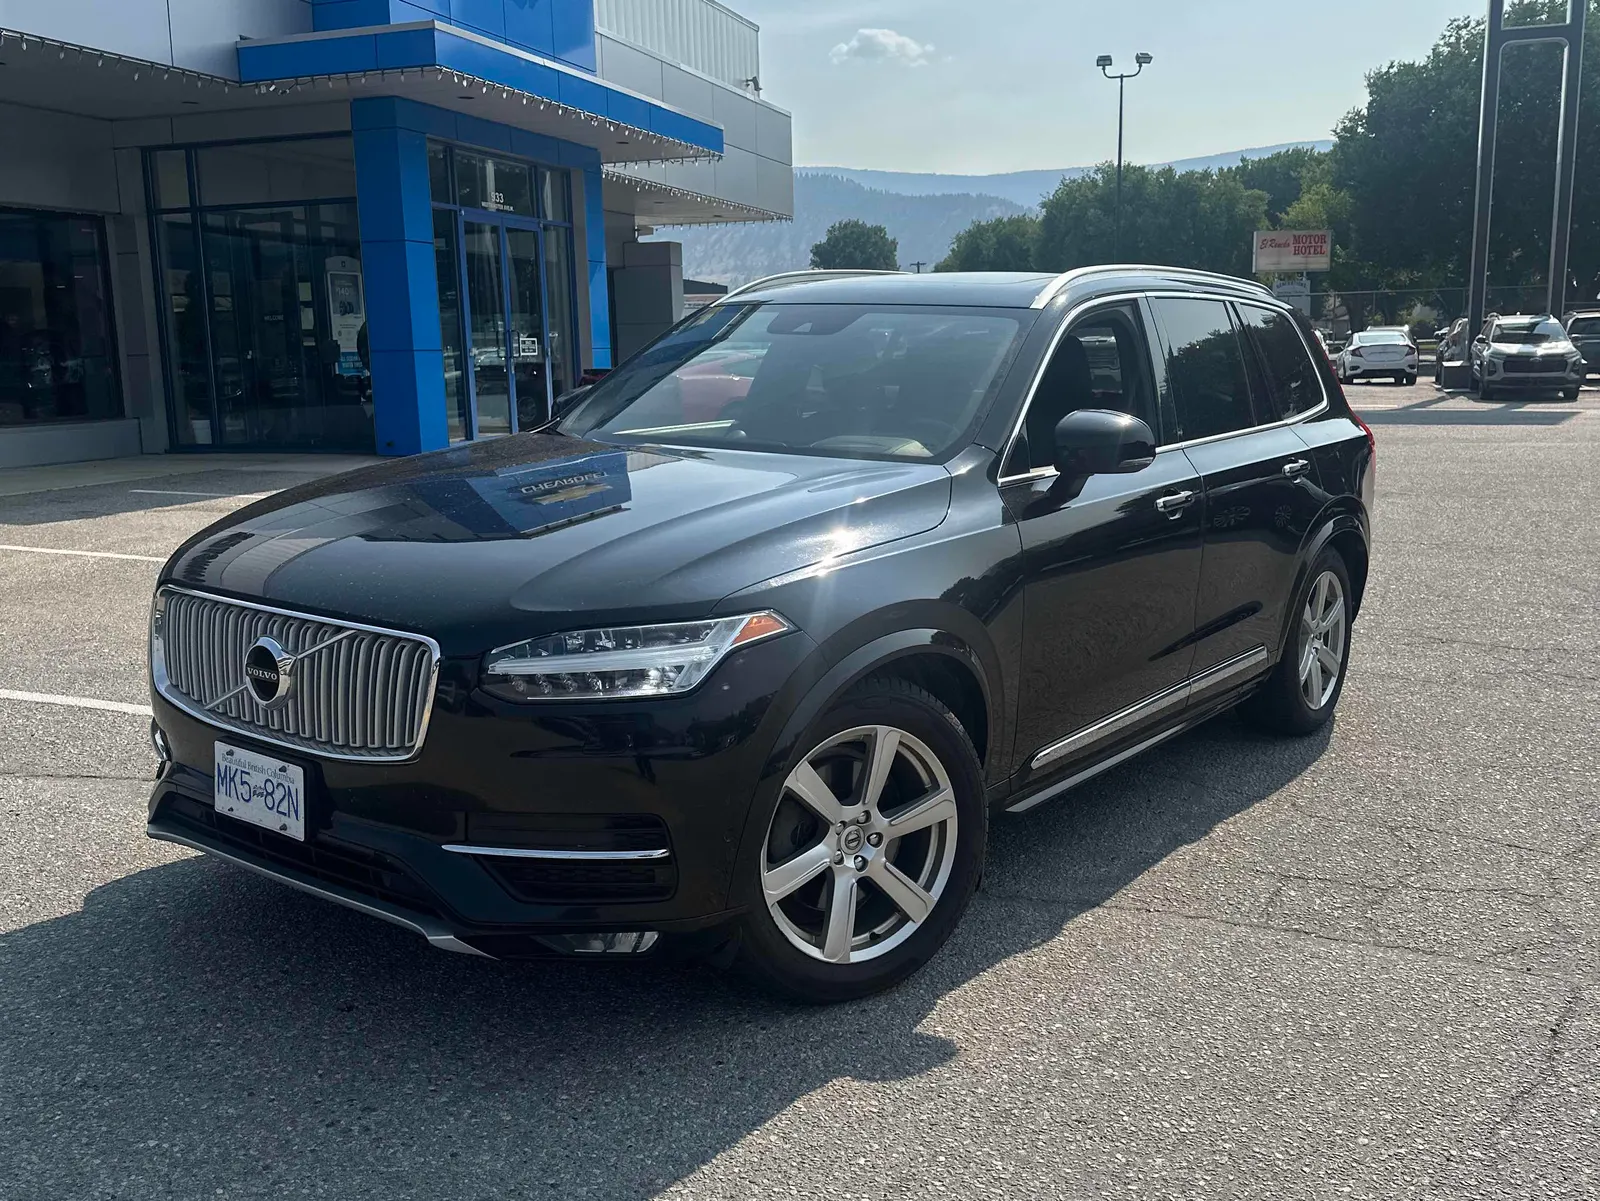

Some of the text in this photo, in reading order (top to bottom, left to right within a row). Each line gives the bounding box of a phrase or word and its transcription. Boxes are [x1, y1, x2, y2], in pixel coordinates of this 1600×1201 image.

[490, 191, 504, 203] 933
[1260, 238, 1268, 249] El
[1292, 234, 1327, 245] MOTOR
[1292, 245, 1326, 256] HOTEL
[246, 667, 278, 681] VOLVO
[221, 753, 295, 785] Beautiful British Columbia
[217, 762, 299, 821] MK5 82N
